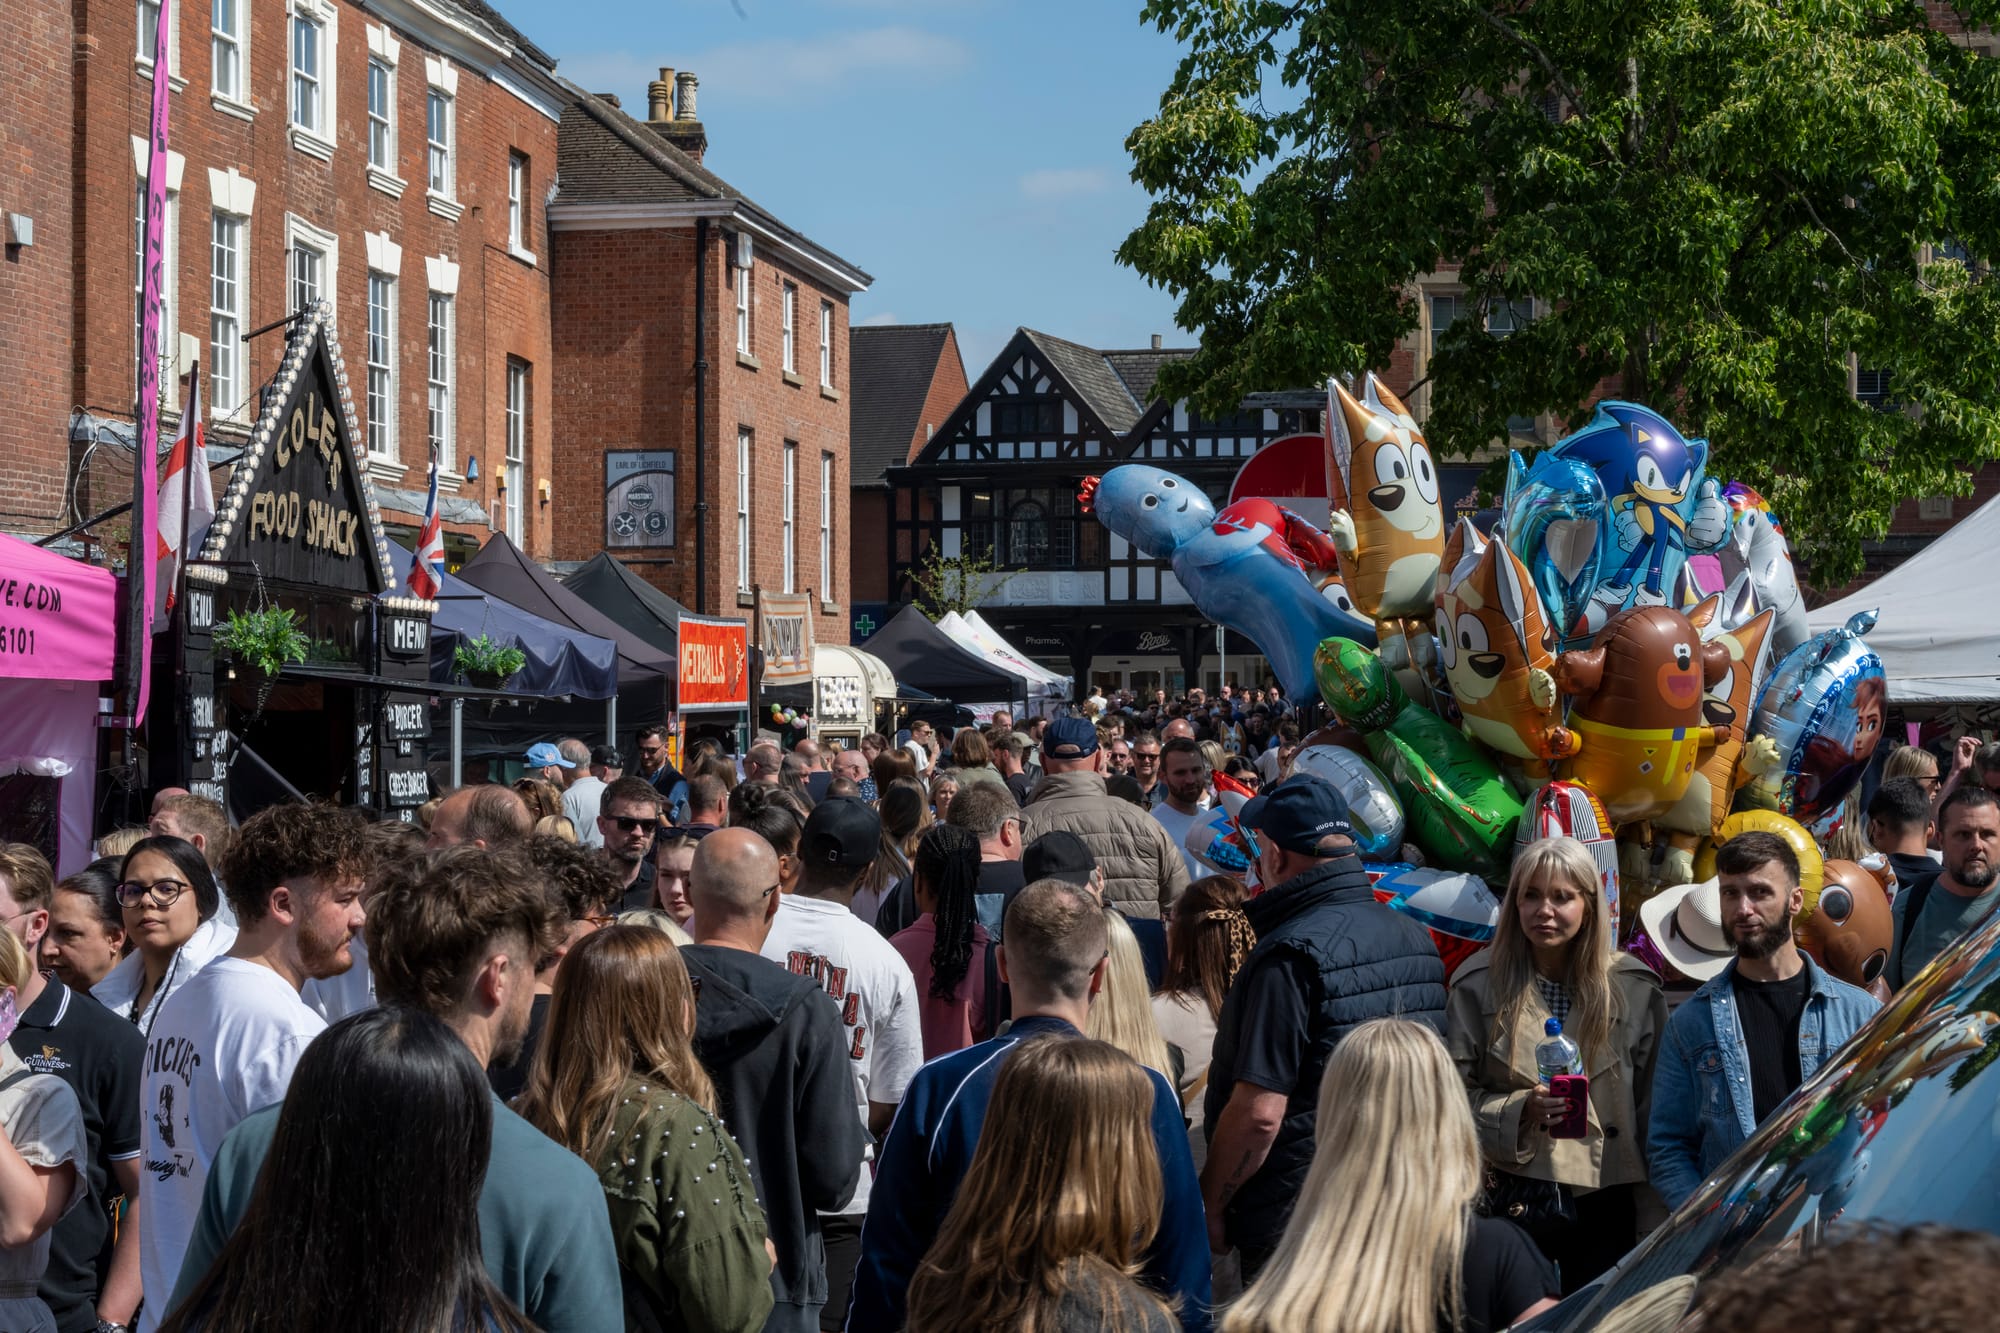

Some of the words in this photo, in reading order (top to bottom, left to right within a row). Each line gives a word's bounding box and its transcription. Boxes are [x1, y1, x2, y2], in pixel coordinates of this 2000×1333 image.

[638, 461, 667, 469] LICHFIELD
[250, 490, 301, 541] FOOD
[306, 499, 359, 557] SHACK
[190, 592, 213, 627] MENU
[393, 619, 427, 649] MENU
[680, 642, 726, 684] MEATBALLS
[394, 703, 423, 731] BURGER
[1315, 821, 1334, 832] HUGO
[24, 1056, 66, 1070] GUINNESS
[146, 1036, 201, 1088] DICKIES
